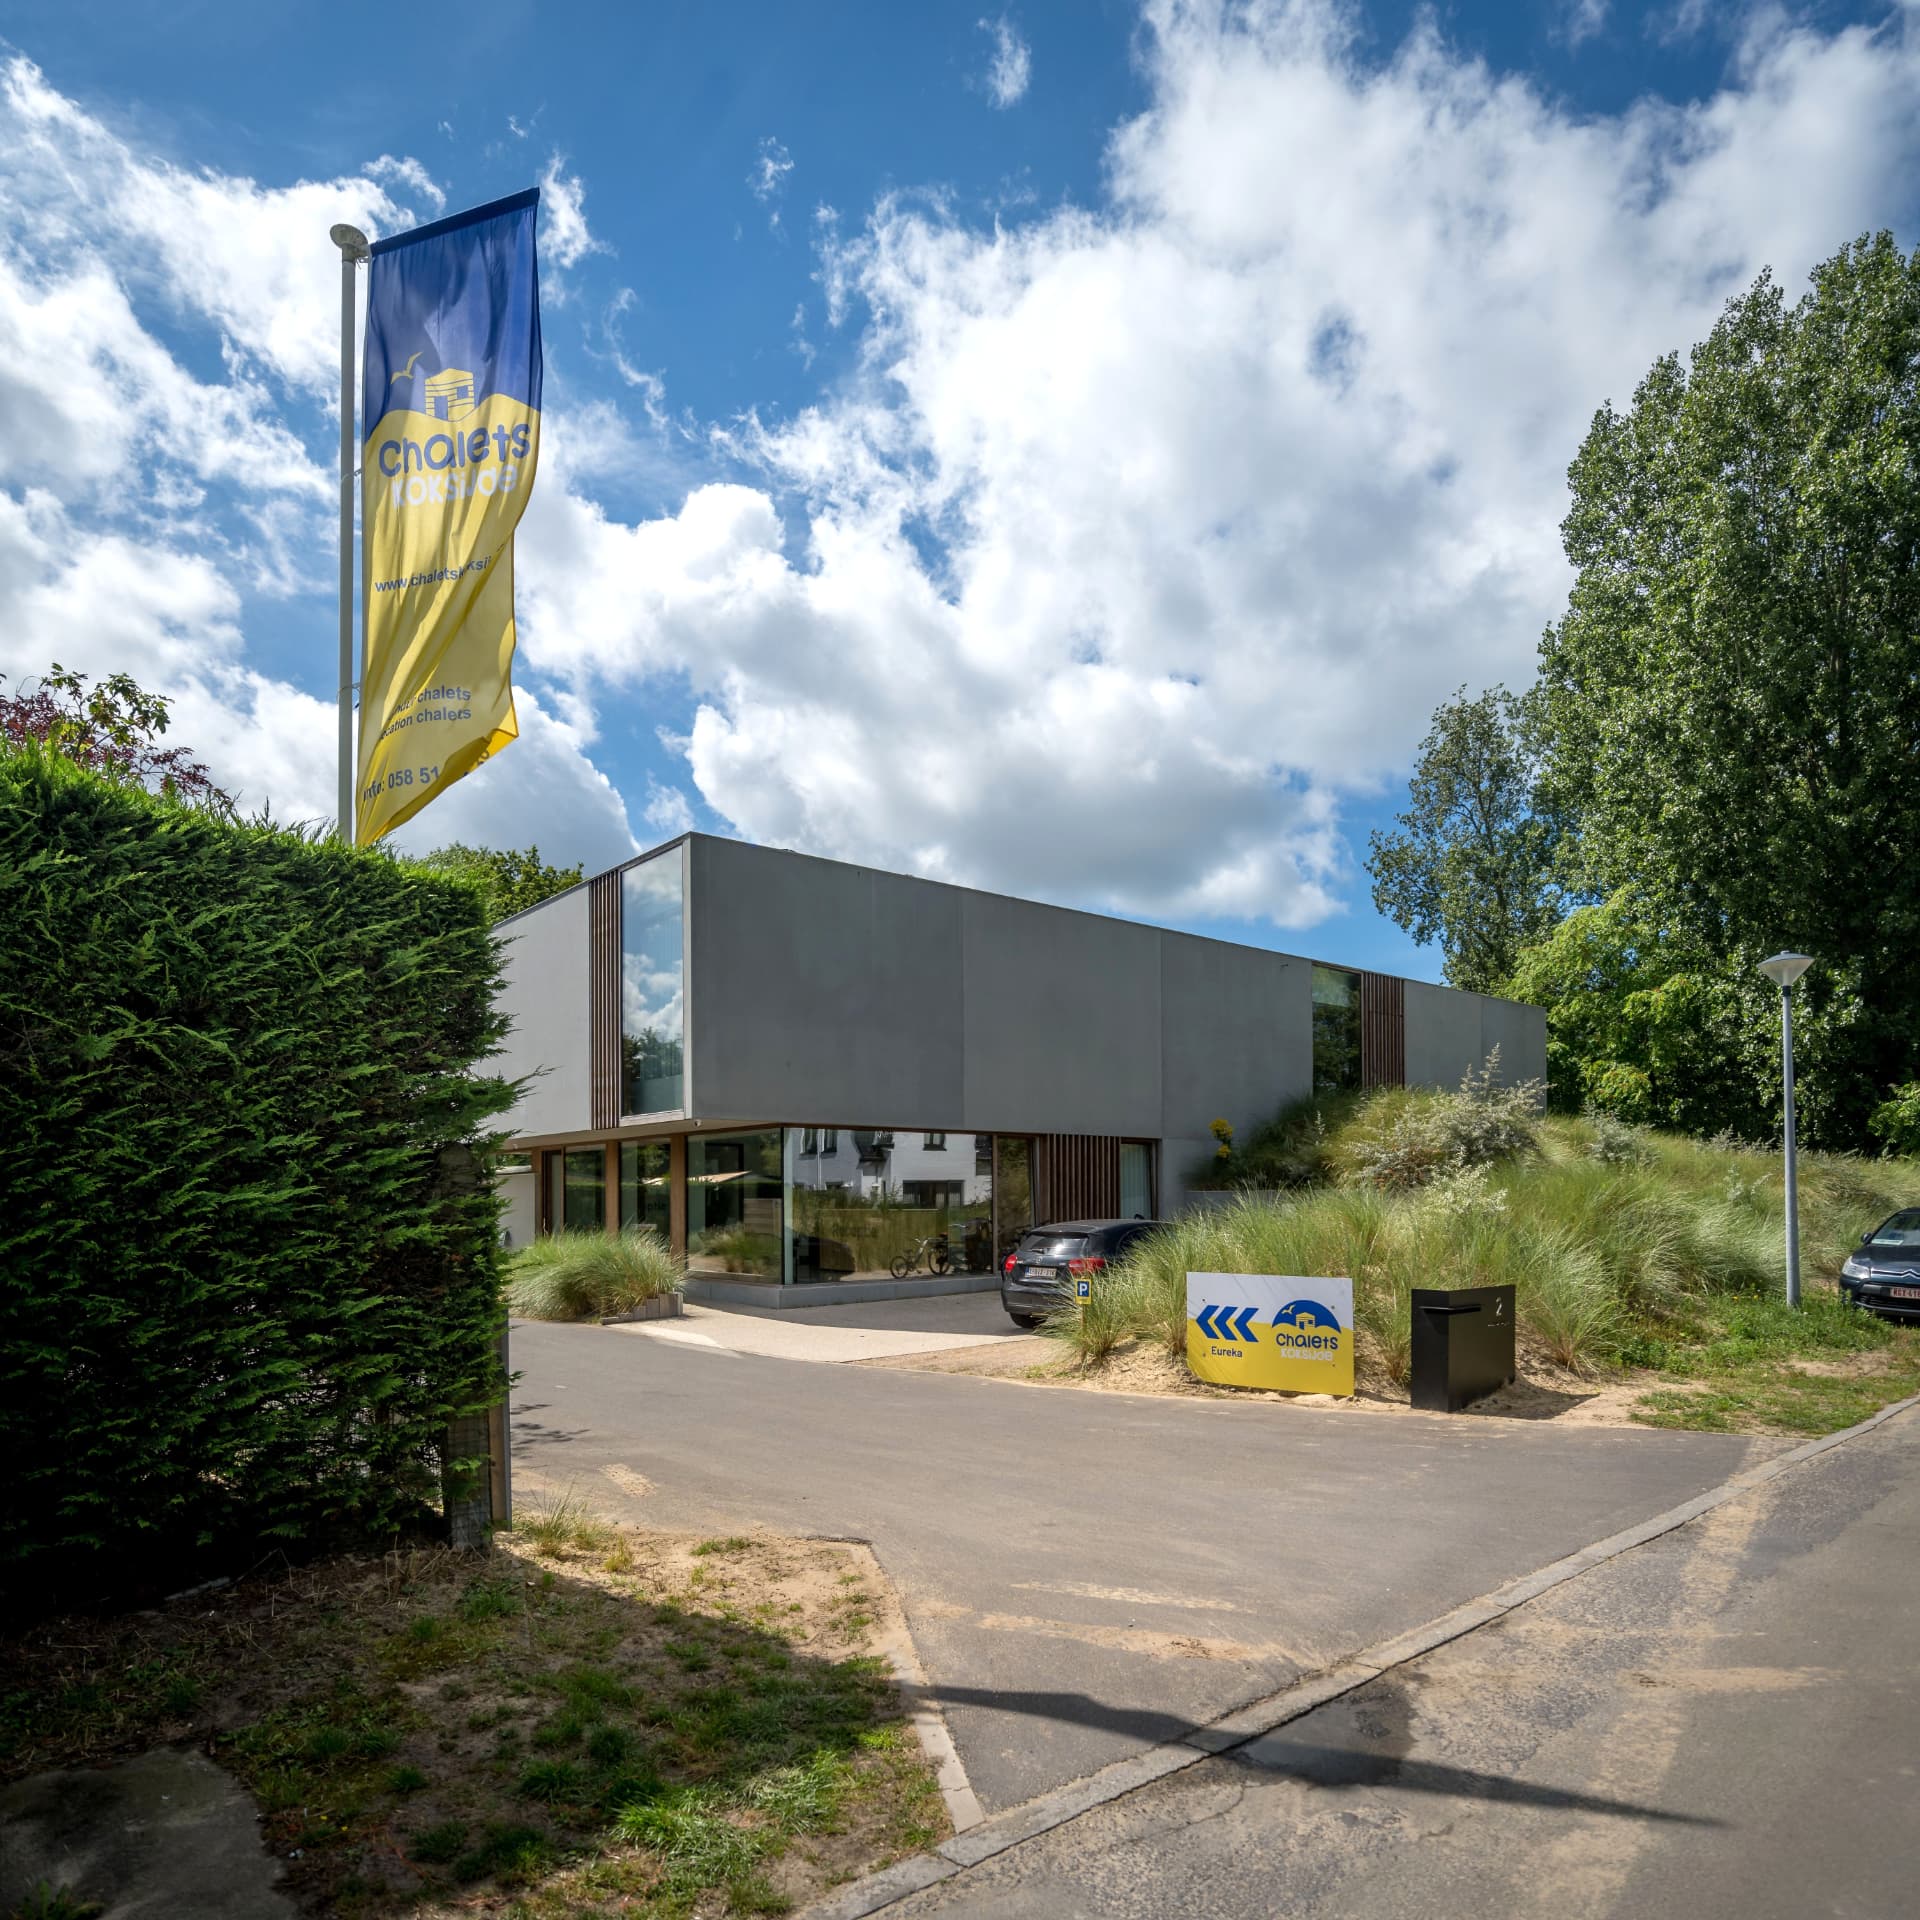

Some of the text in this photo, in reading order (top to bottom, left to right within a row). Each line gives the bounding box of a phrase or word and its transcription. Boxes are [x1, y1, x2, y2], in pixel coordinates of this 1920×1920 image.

[417, 684, 471, 703] chalets
[416, 707, 471, 723] chalets
[388, 769, 413, 789] 058
[419, 766, 440, 784] 51
[1079, 1282, 1088, 1296] P
[1495, 1296, 1502, 1316] 2
[1211, 1346, 1243, 1358] Eureka
